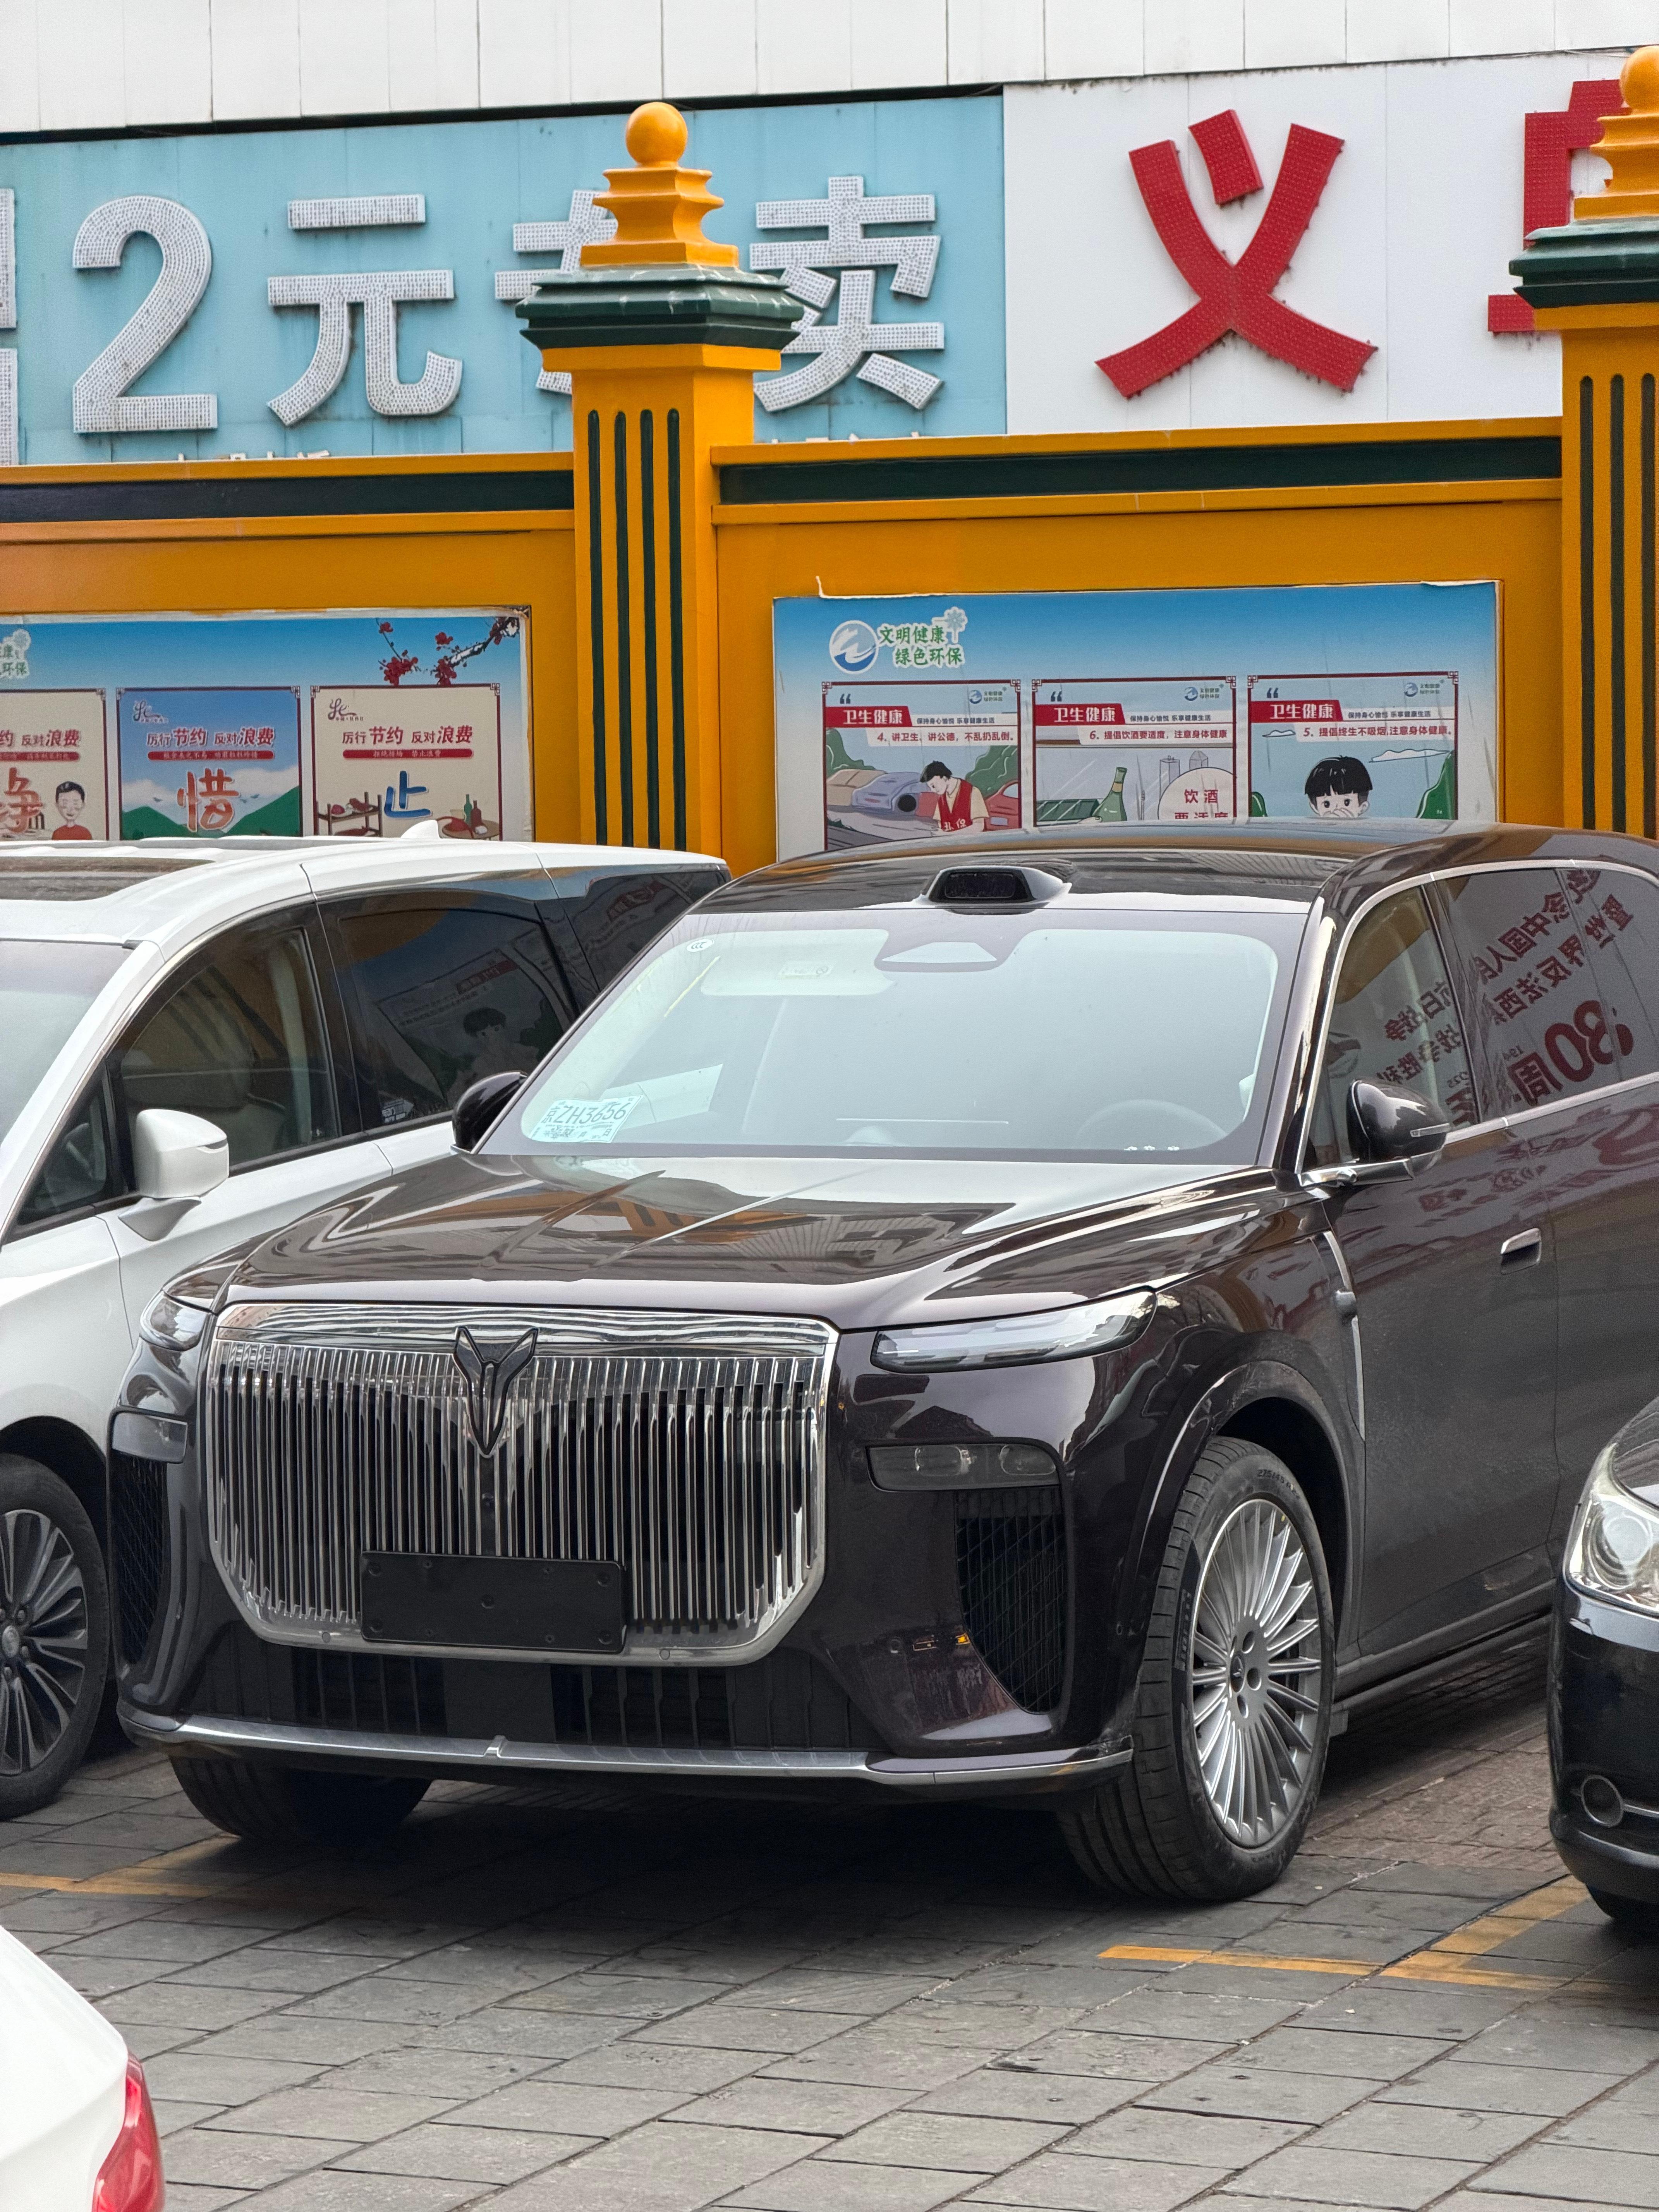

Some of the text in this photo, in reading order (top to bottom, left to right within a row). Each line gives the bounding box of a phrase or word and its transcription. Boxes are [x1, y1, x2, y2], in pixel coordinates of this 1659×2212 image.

[0, 176, 944, 466] 2元卖
[879, 626, 945, 644] 文明健康
[895, 647, 962, 666] 绿色环保
[843, 709, 903, 725] 卫生健康
[1054, 707, 1116, 722] 卫生健康
[1270, 703, 1334, 719] 卫生健康
[148, 727, 275, 747] 厉行节约 反对浪费
[342, 725, 473, 745] 厉行节约 反对浪费
[177, 768, 240, 832] 惜
[384, 770, 432, 818] 止
[1184, 789, 1218, 804] 饮酒
